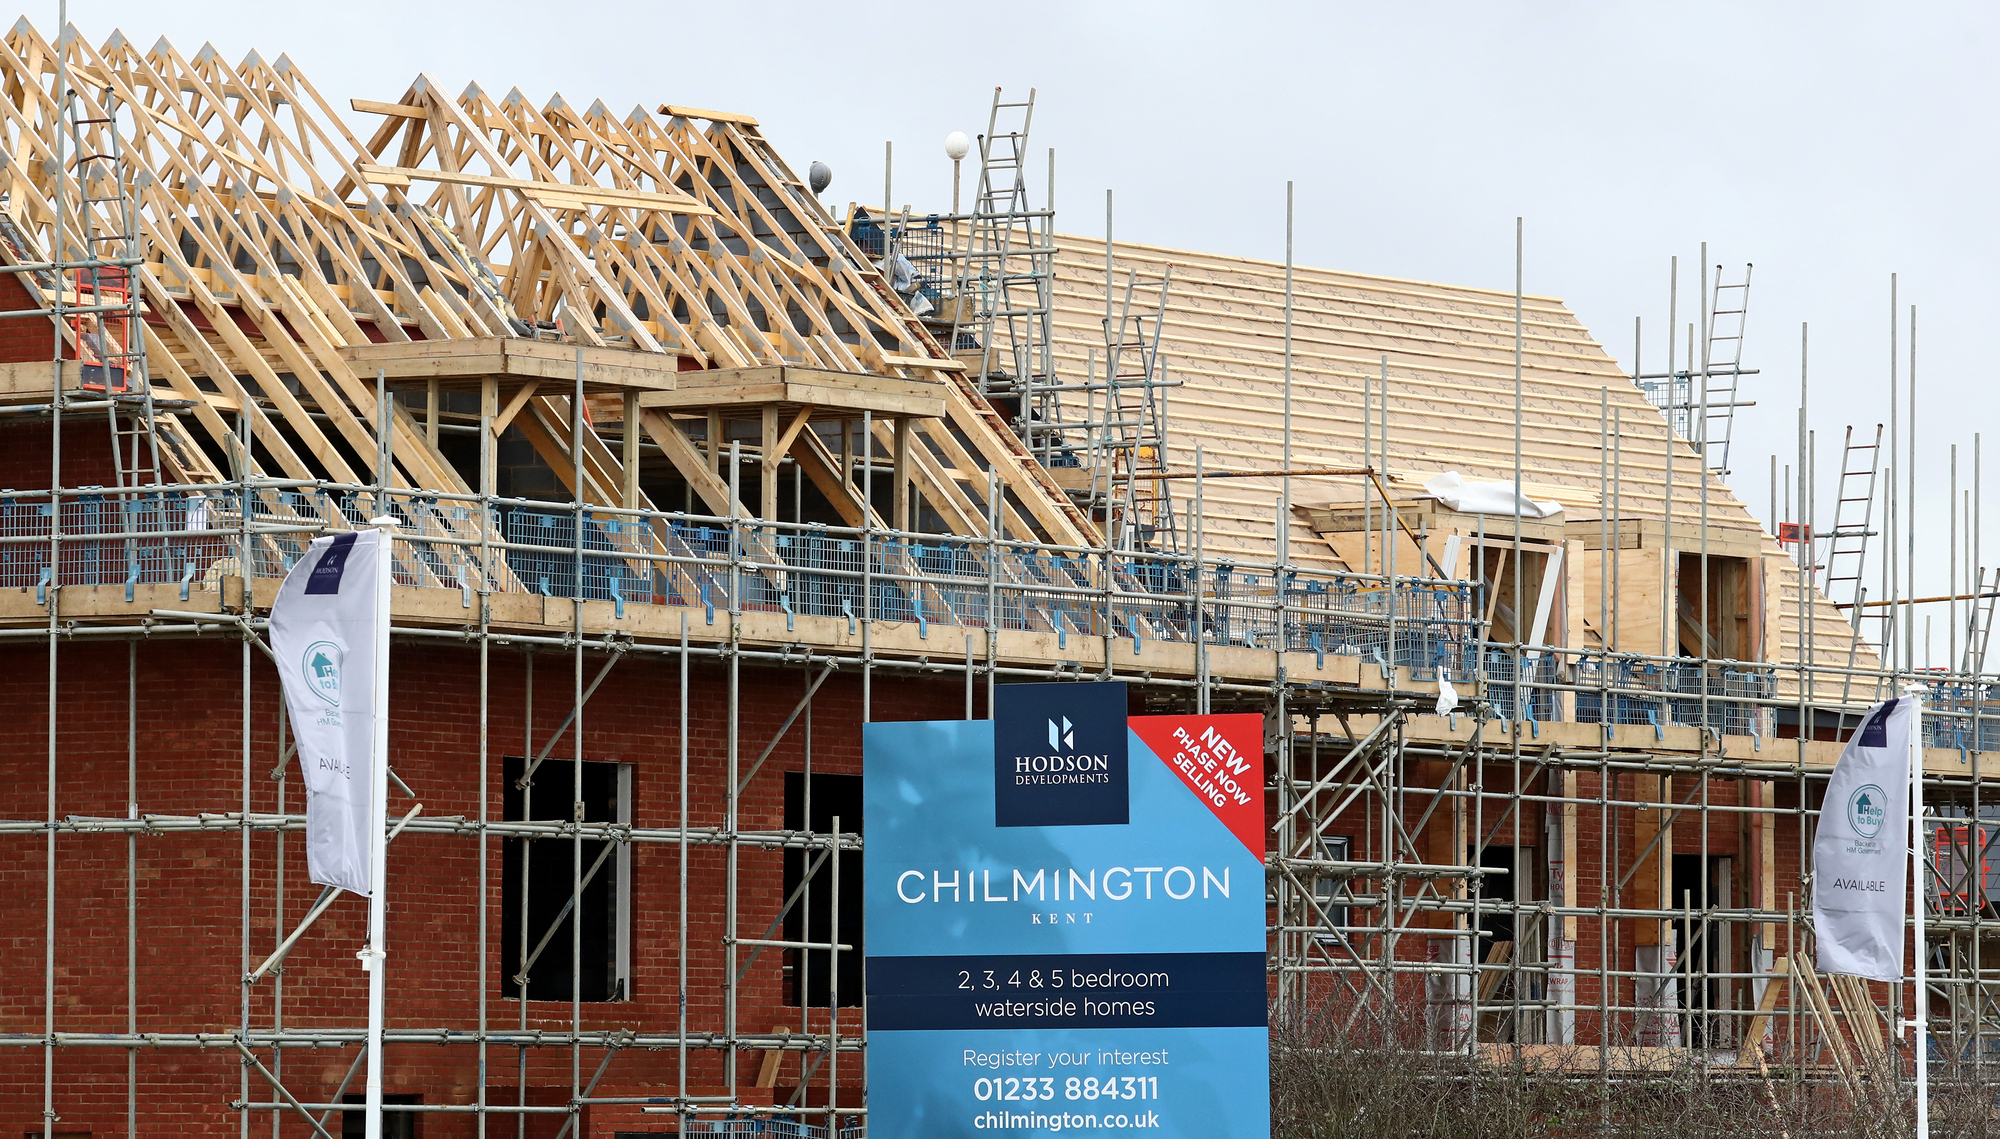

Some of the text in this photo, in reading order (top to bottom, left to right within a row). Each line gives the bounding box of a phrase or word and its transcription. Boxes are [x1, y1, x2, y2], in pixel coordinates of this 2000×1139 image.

[319, 679, 332, 689] to
[1199, 726, 1252, 776] NEW
[1015, 754, 1109, 773] HODSON
[1172, 726, 1252, 806] PHASE NOW
[1015, 772, 1110, 786] DEVELOPMENTS
[1172, 752, 1227, 808] SELLING
[1857, 816, 1881, 827] to Buy
[1863, 806, 1883, 817] Help
[896, 865, 1230, 904] CHILMINGTON
[1833, 878, 1885, 892] AVAILABLE
[1031, 912, 1093, 925] KENT
[958, 968, 1169, 991] 2, 3, 4 & 5 bedroom
[974, 996, 1155, 1017] waterside homes
[963, 1048, 1169, 1070] Register your interest
[973, 1076, 1158, 1101] 01233 884311
[974, 1110, 1160, 1132] chilmington.co.uk
